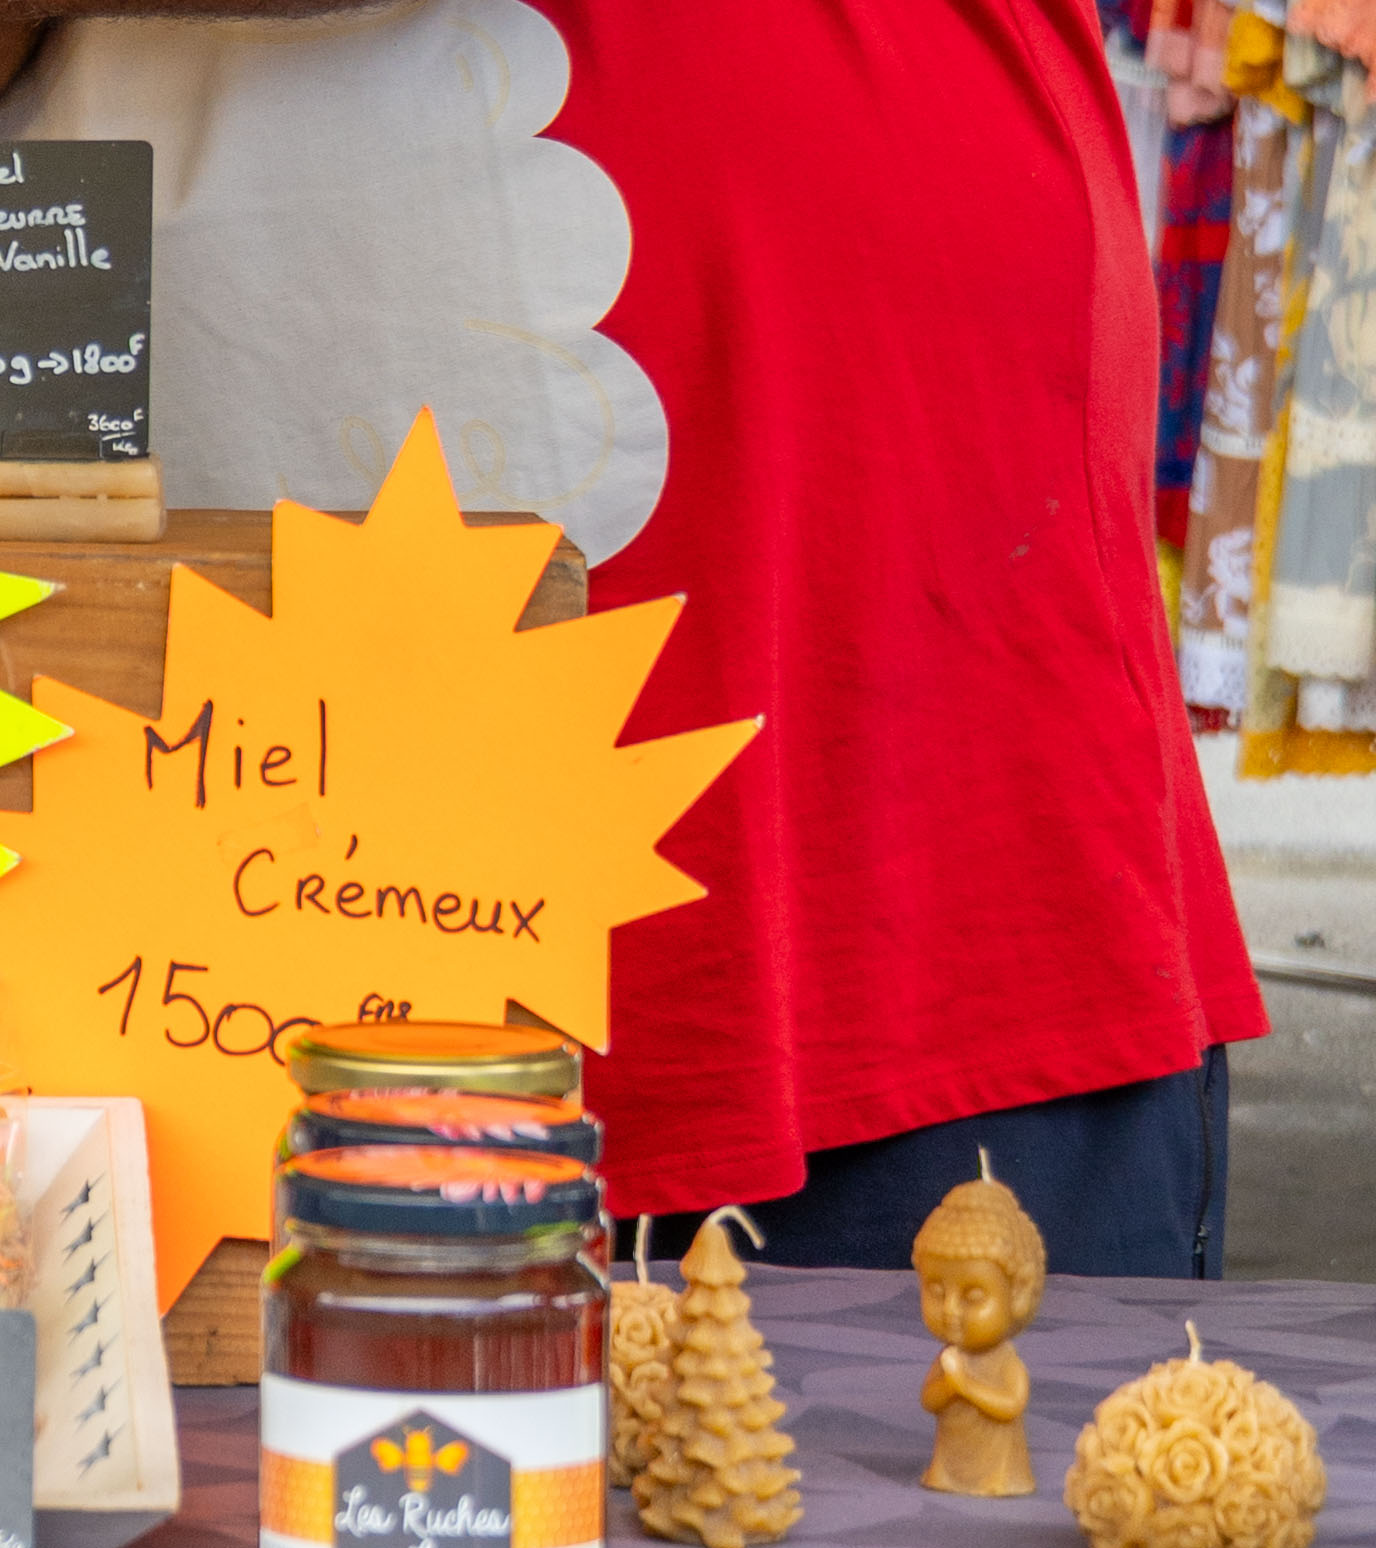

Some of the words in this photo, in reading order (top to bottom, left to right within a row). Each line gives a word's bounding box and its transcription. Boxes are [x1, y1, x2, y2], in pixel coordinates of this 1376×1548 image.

[143, 698, 330, 810] Miel
[335, 1483, 396, 1539] Les
[398, 1491, 512, 1539] Ruches
